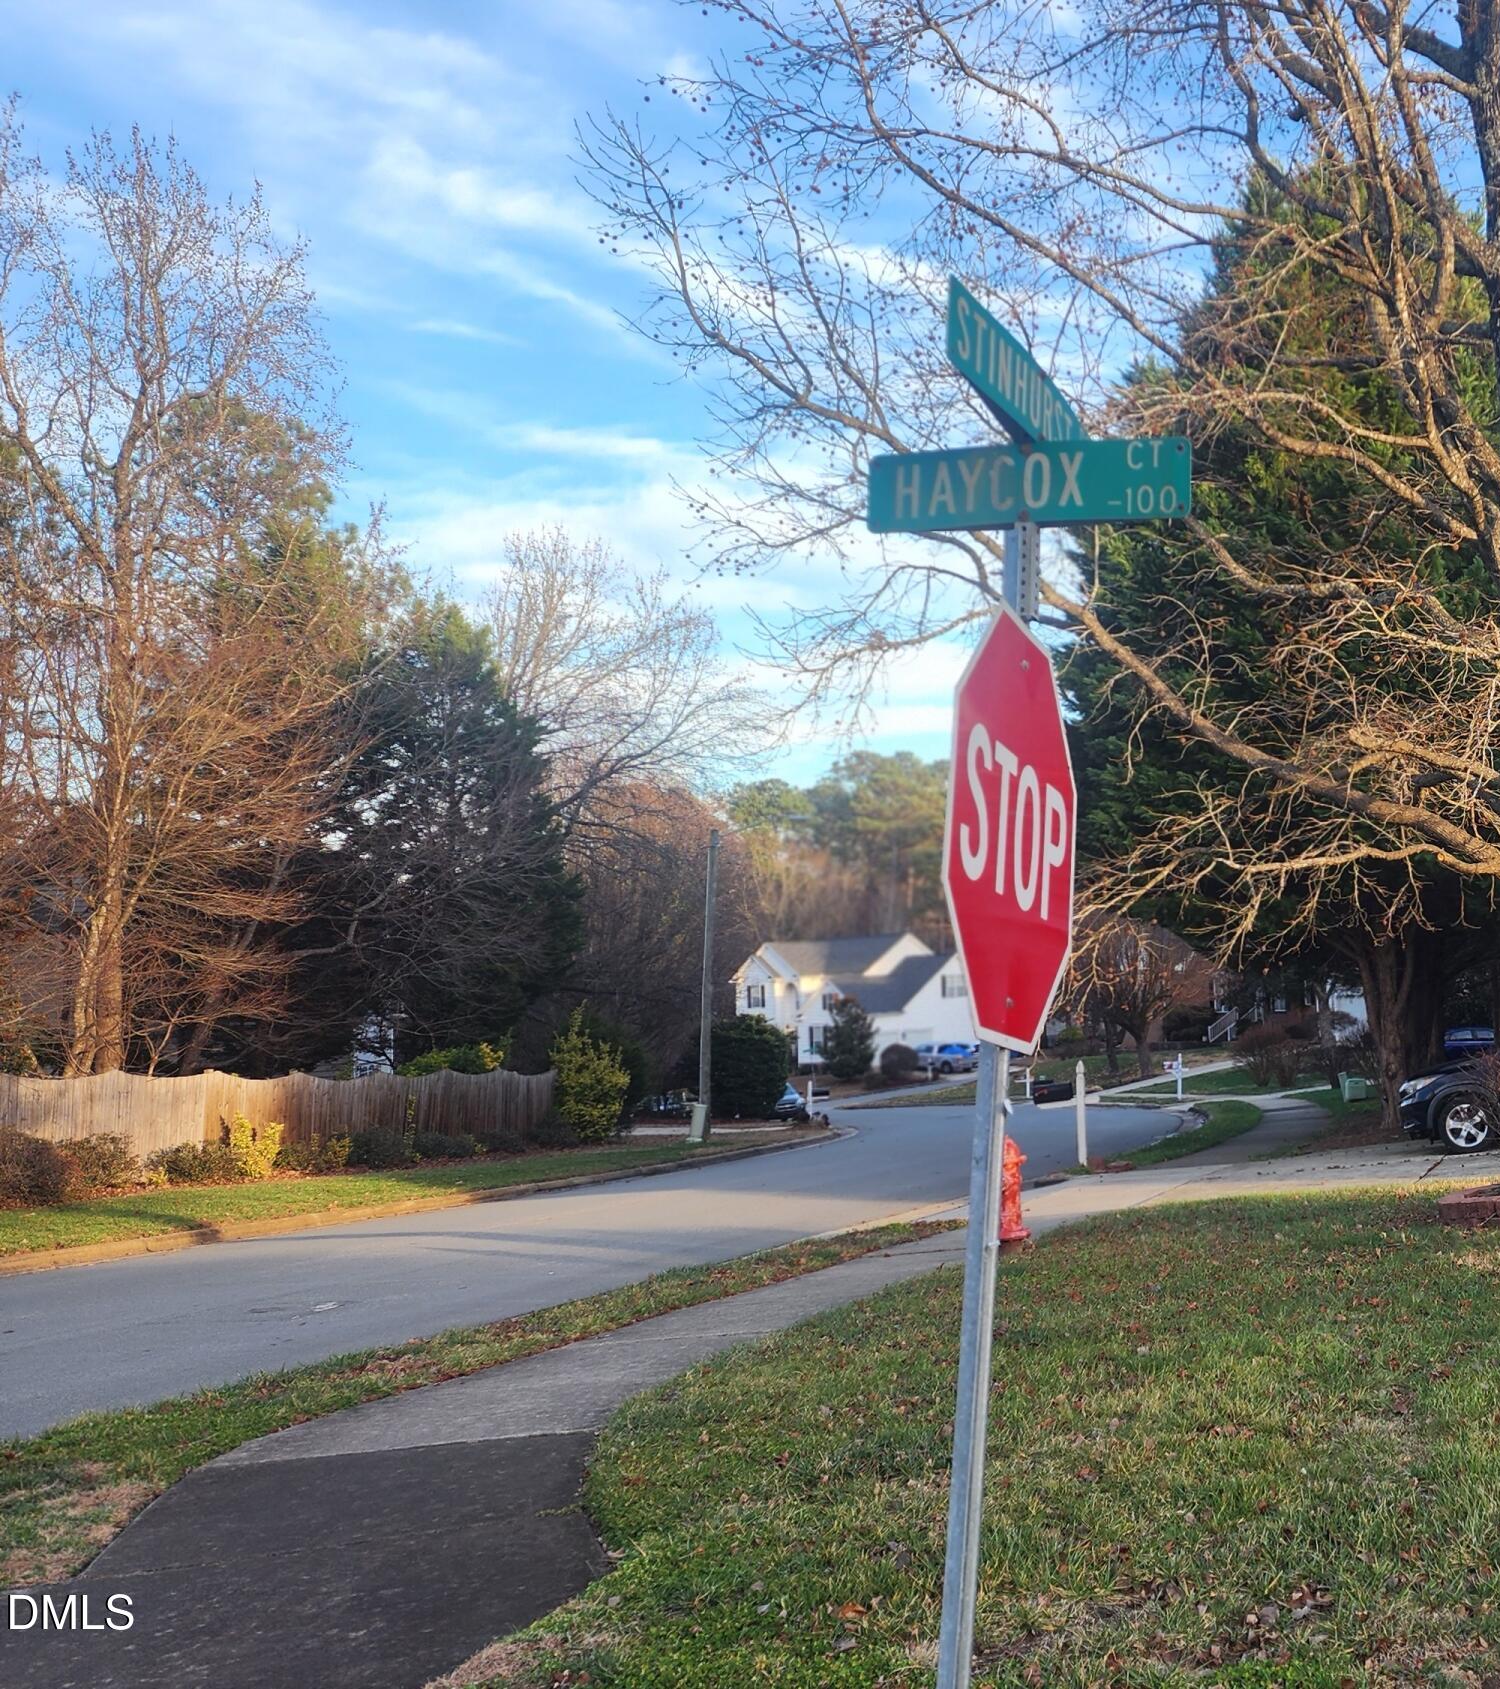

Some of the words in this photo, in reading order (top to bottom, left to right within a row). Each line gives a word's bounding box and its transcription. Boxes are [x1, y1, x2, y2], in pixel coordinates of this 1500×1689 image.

[956, 296, 1073, 441] STINHURST
[894, 452, 1084, 519] HAYCOX
[1127, 440, 1164, 470] CT
[1107, 485, 1177, 514] -100
[960, 723, 1067, 921] STOP
